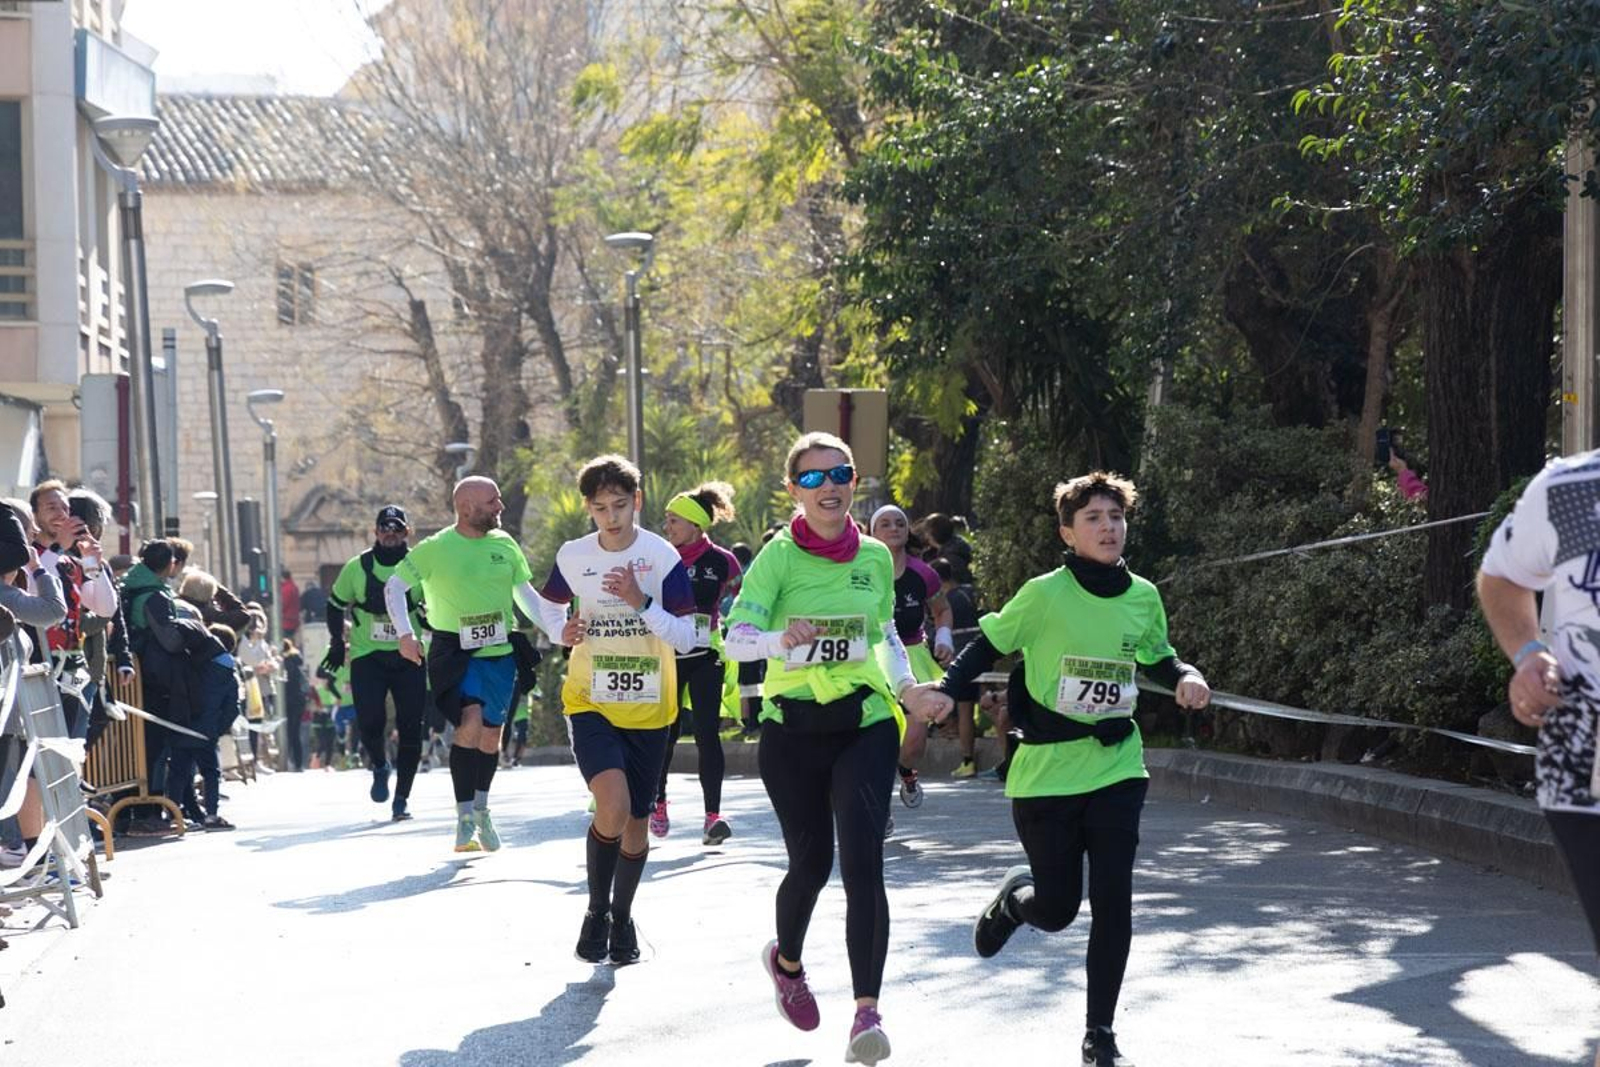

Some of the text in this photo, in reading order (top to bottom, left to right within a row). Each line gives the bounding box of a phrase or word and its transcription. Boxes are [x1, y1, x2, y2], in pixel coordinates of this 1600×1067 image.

[471, 624, 496, 640] 530
[587, 628, 601, 637] OS
[590, 619, 622, 628] SANTA
[806, 639, 849, 662] 798
[607, 671, 644, 691] 395
[1077, 680, 1121, 705] 799
